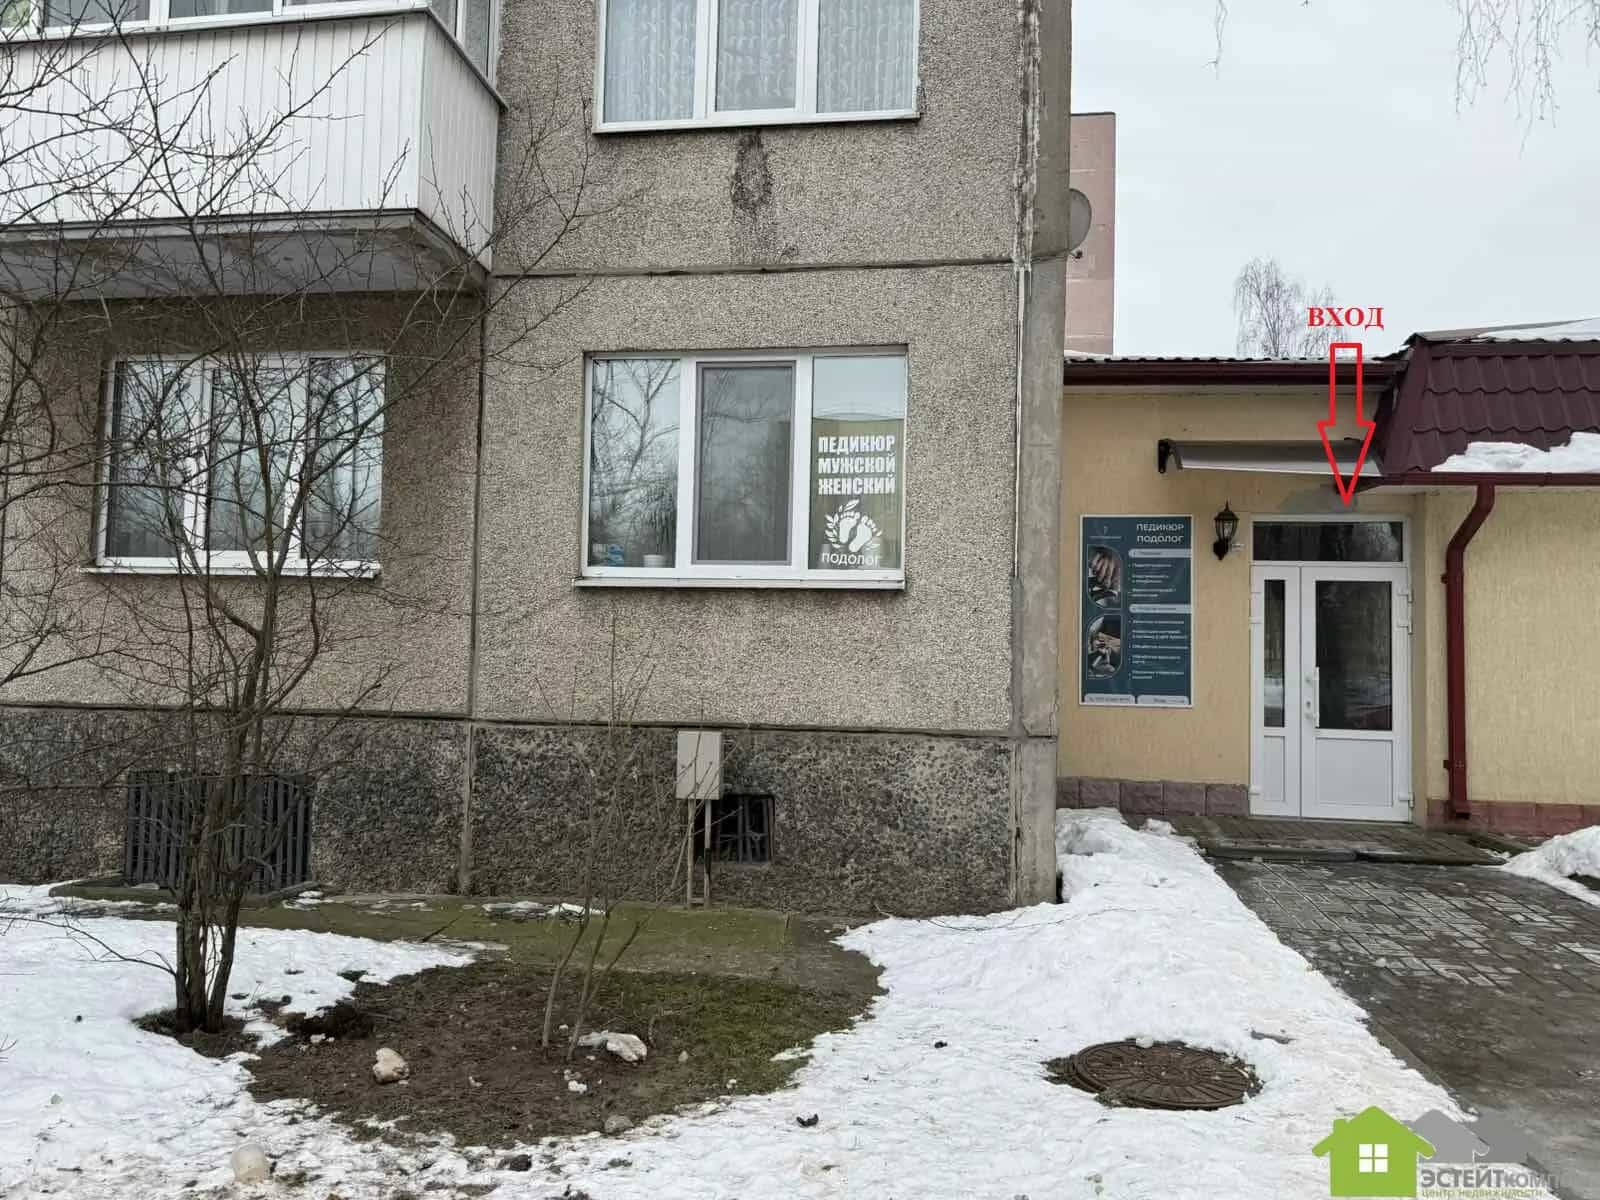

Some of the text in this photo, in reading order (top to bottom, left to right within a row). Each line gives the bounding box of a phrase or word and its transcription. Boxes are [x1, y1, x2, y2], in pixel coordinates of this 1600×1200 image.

[818, 435, 896, 454] ПЕДИКЮР
[818, 453, 896, 474] МУЖСКОЙ
[818, 474, 896, 495] ЖЕНСКИЙ
[1136, 523, 1185, 532] ПЕДИКЮР
[1136, 535, 1185, 544] ПОДОЛОГ
